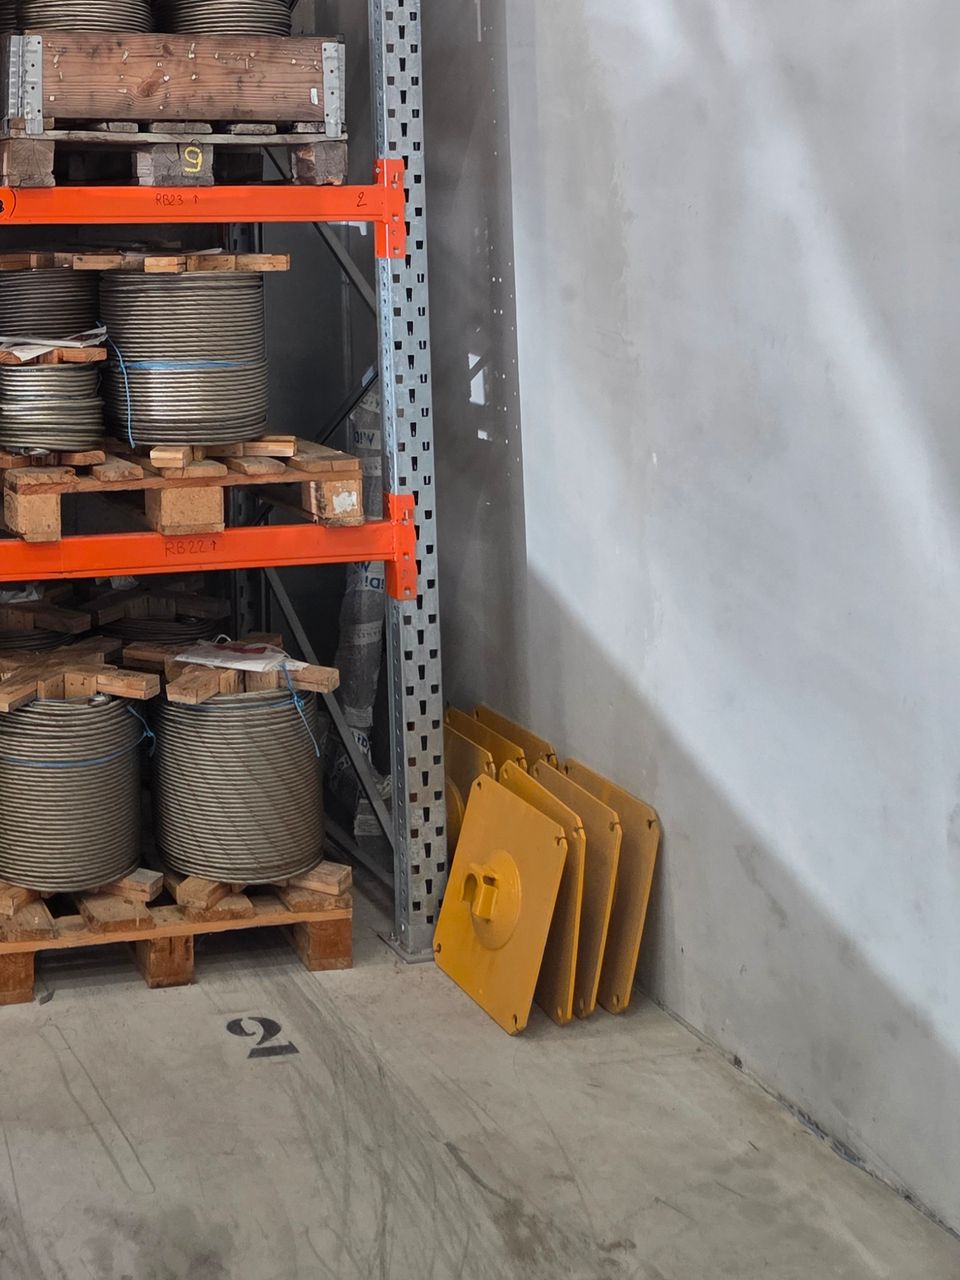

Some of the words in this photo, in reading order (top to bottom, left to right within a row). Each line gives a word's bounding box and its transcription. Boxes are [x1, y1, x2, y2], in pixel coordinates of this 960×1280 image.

[153, 192, 185, 208] RB23
[163, 539, 208, 558] RB22
[225, 1014, 301, 1060] 2
